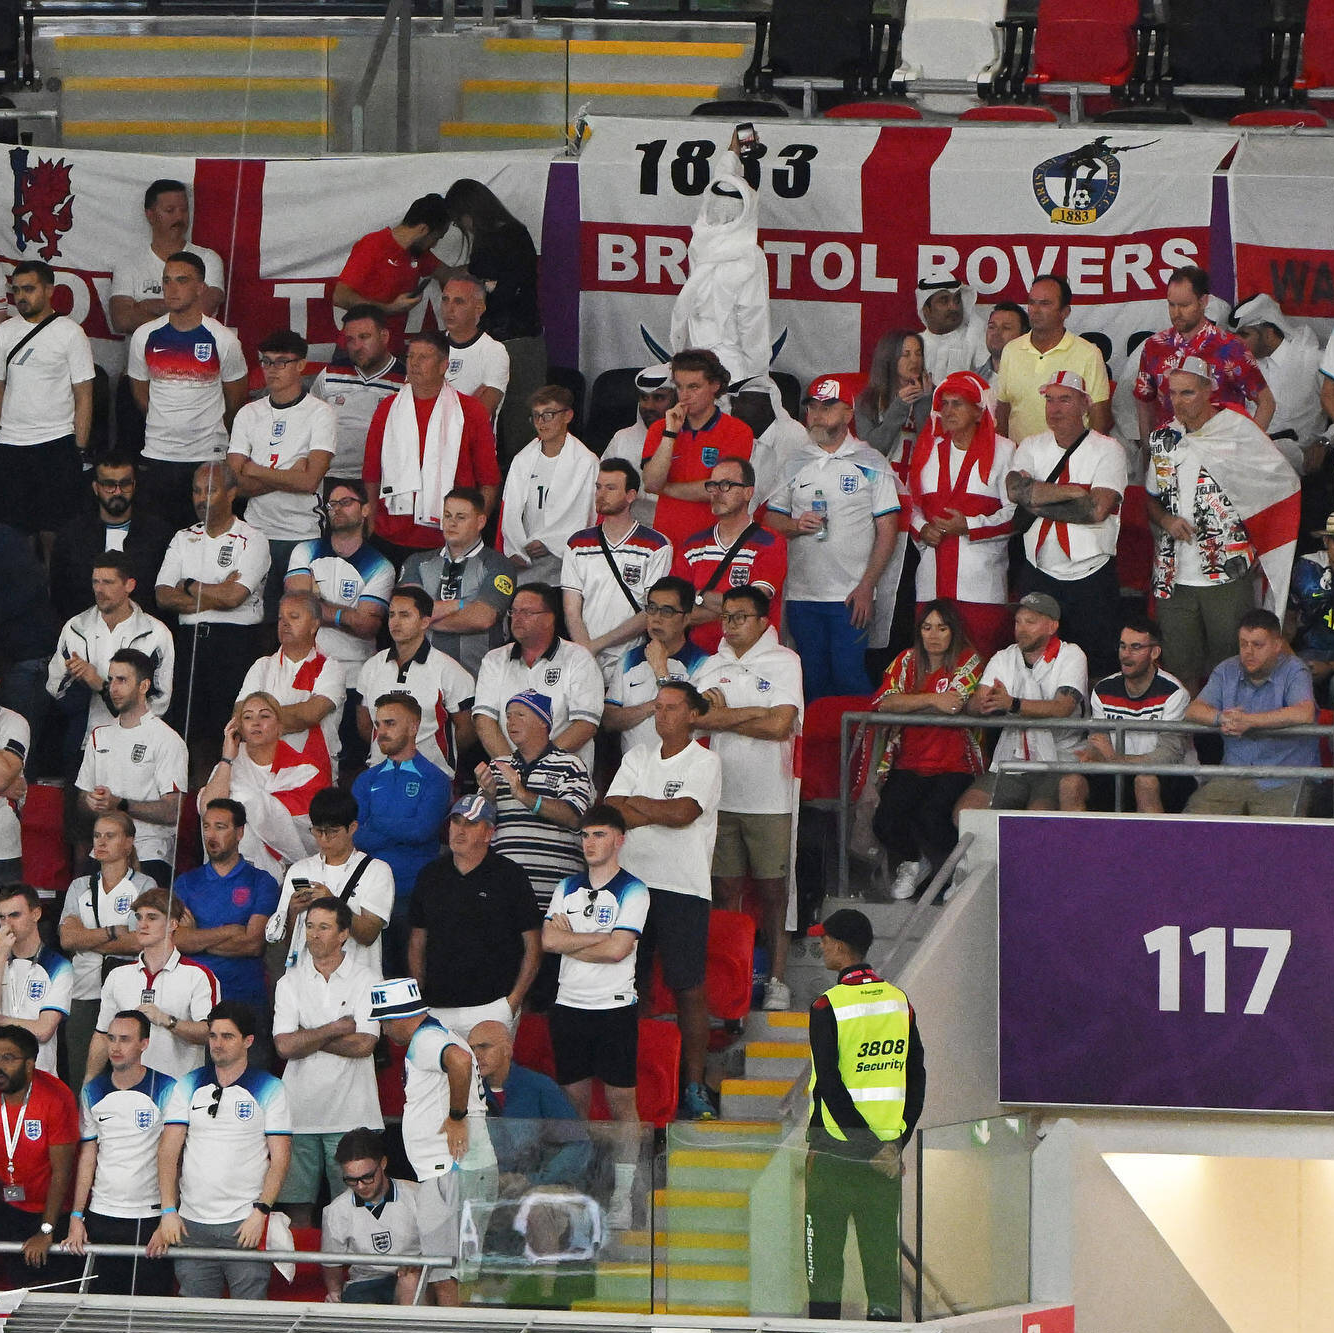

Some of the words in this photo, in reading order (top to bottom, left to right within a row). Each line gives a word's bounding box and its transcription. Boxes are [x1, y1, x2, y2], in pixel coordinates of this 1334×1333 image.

[1060, 210, 1089, 223] 1883
[598, 233, 898, 293] BRTOL
[916, 237, 1199, 297] ROVERS
[1143, 925, 1291, 1015] 117
[857, 1039, 904, 1057] 3808
[856, 1059, 905, 1073] Security
